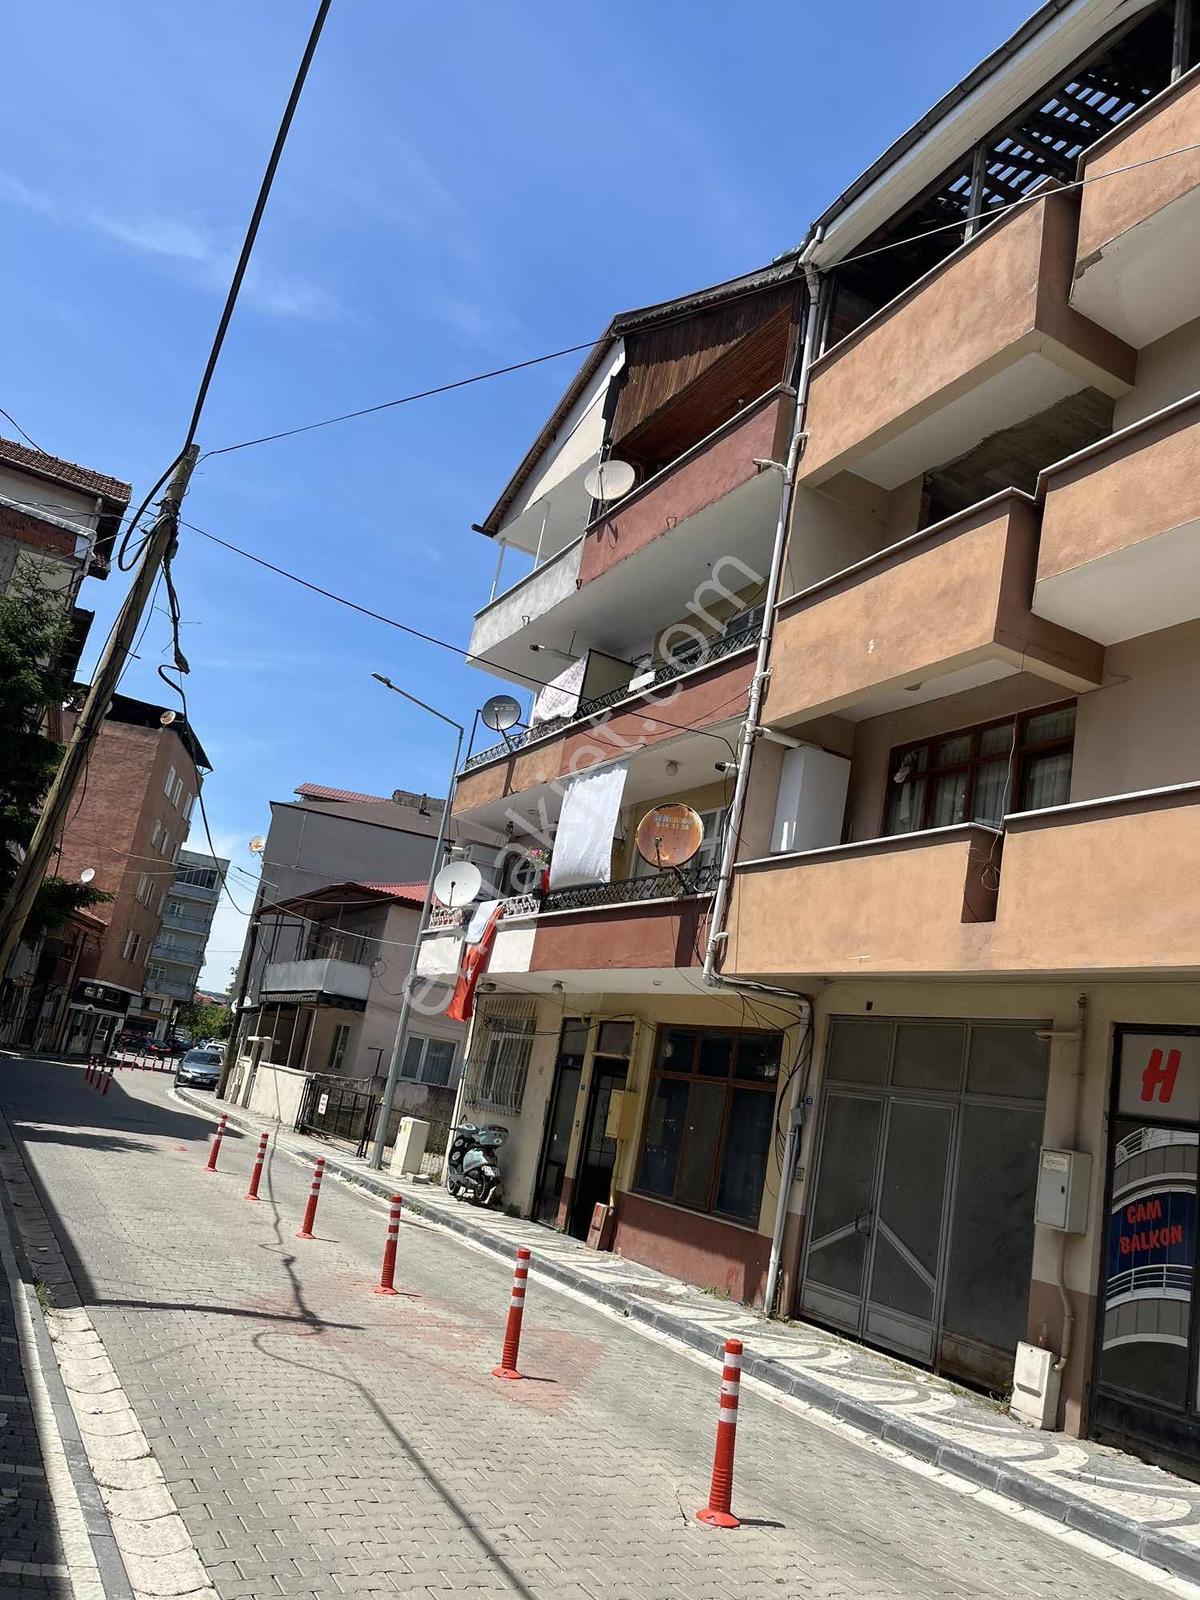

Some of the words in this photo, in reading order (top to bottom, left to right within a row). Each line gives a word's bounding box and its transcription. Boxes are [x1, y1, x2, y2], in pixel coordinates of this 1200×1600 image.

[1141, 1048, 1181, 1103] H
[1127, 1200, 1162, 1224] CAM
[1120, 1225, 1184, 1254] BALKON
